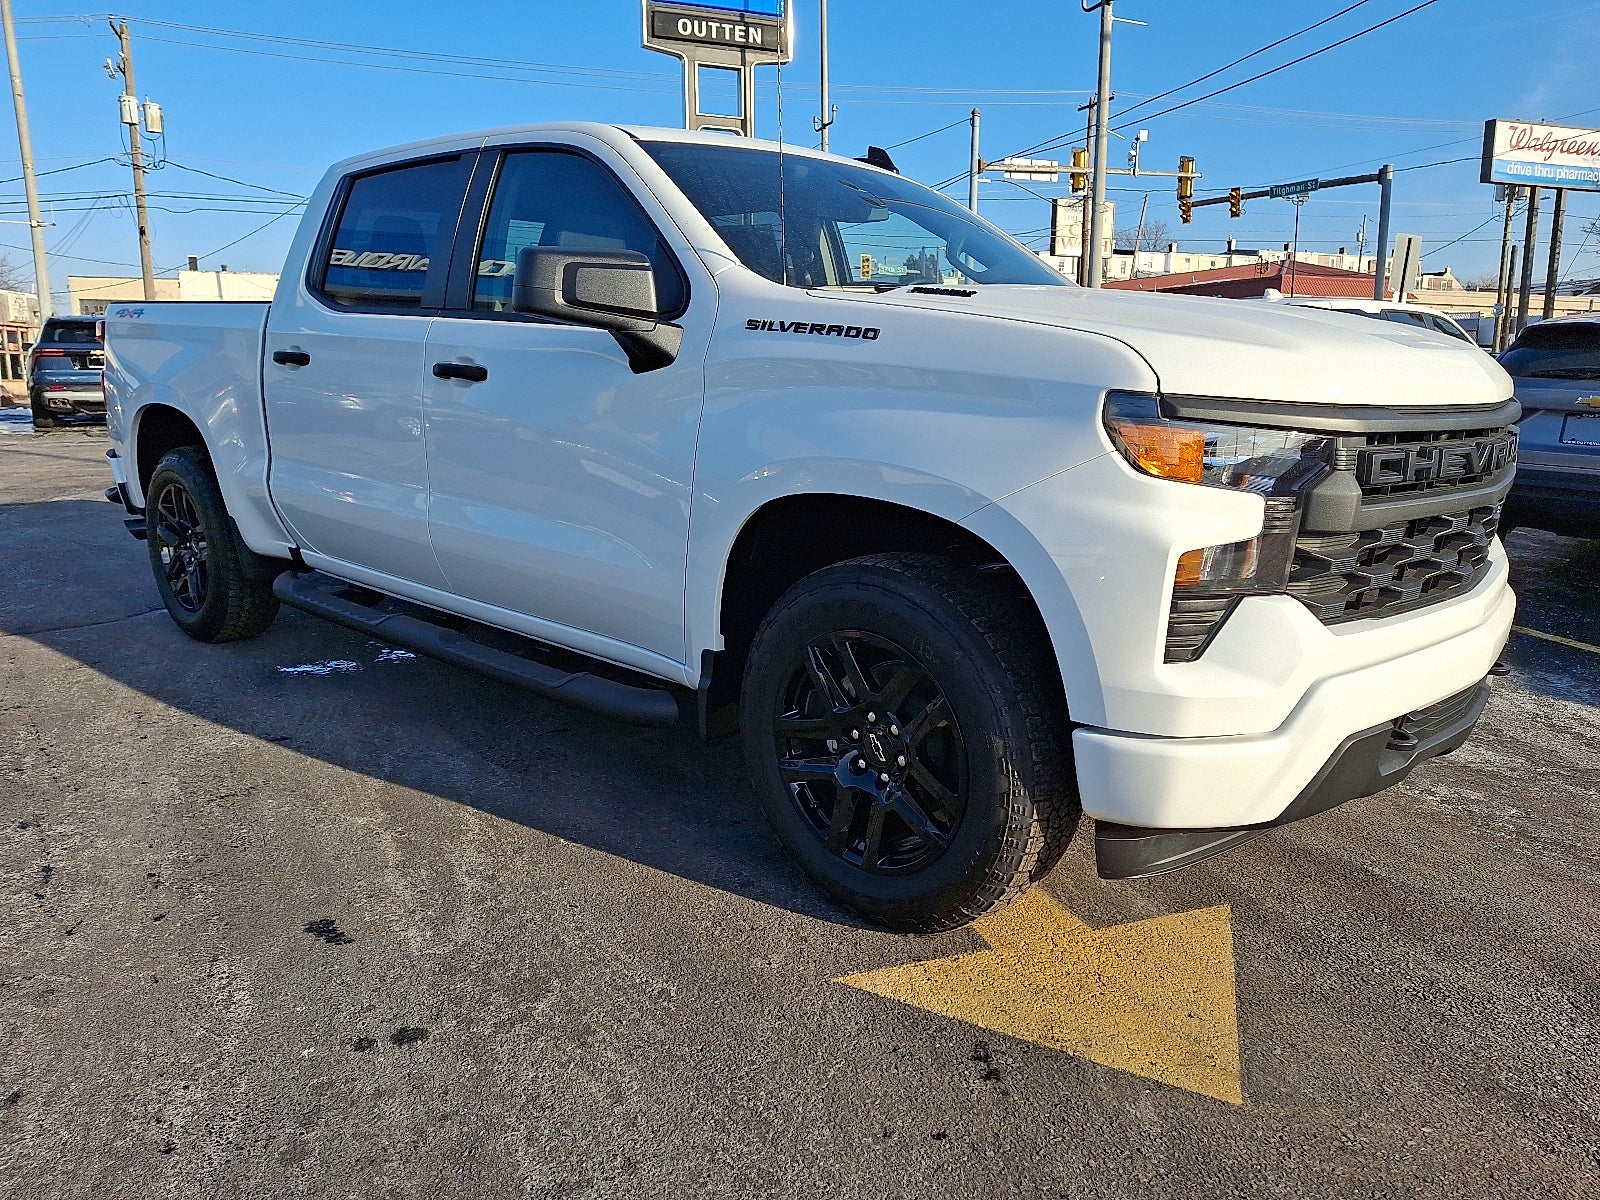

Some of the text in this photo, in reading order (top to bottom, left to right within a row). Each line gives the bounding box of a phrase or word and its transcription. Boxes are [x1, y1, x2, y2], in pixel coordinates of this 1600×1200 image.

[677, 18, 762, 44] OUTTEN
[1508, 125, 1600, 161] Walgreen
[1507, 162, 1532, 176] drive
[1534, 164, 1554, 178] thru
[1273, 181, 1316, 196] Tilghman St
[745, 318, 881, 341] SILVERADO
